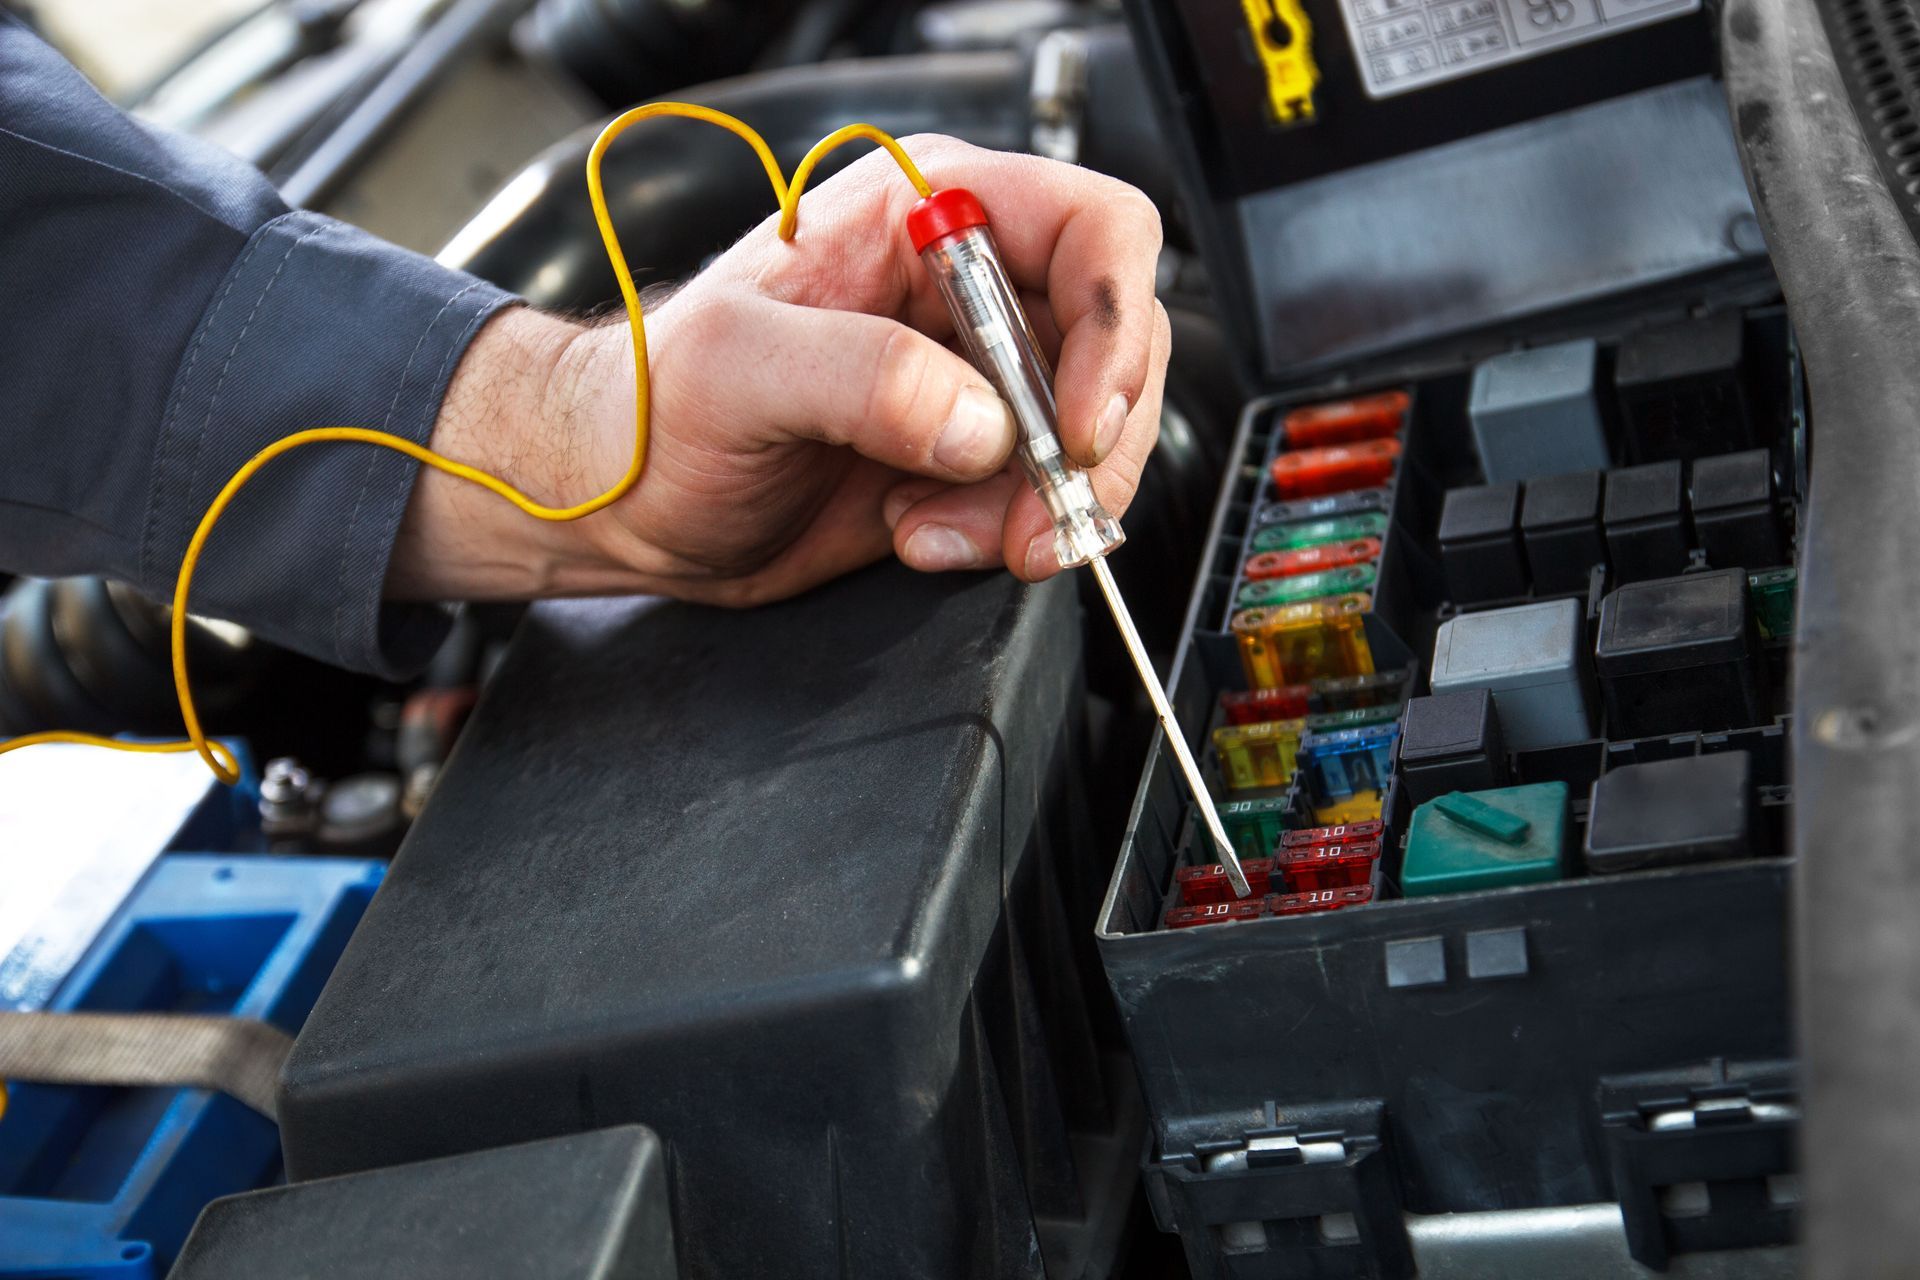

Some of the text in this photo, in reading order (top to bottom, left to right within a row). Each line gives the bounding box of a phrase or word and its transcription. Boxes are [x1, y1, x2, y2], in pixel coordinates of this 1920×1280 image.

[1344, 708, 1366, 720] 30
[1228, 801, 1251, 812] 30
[1322, 826, 1345, 838] 10
[1316, 846, 1341, 858] 10
[1308, 891, 1334, 903] 10
[1203, 904, 1229, 916] 10
